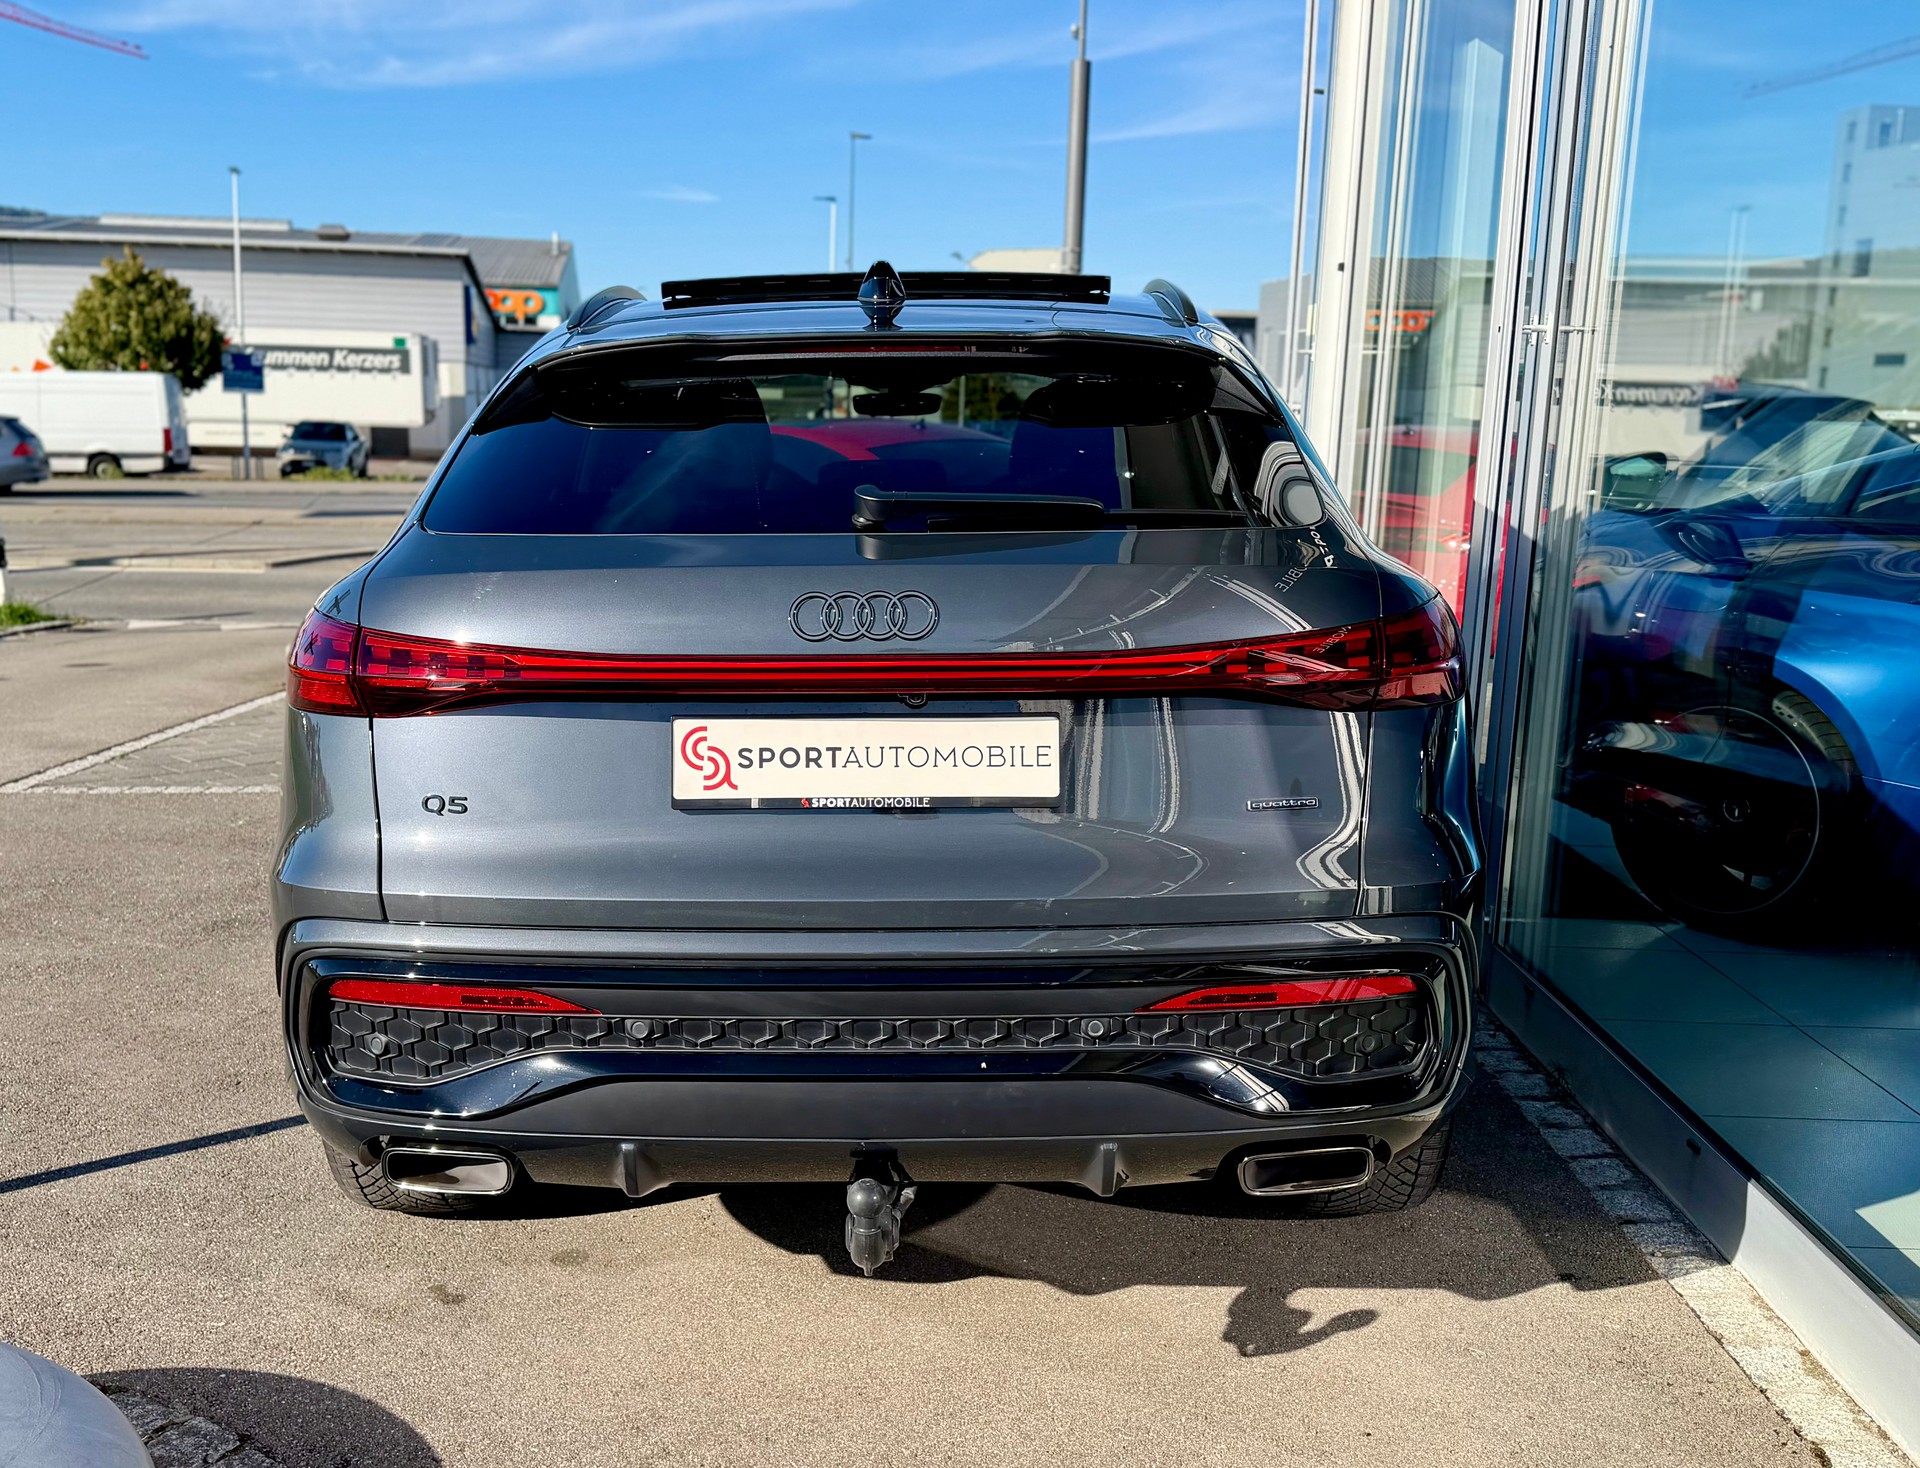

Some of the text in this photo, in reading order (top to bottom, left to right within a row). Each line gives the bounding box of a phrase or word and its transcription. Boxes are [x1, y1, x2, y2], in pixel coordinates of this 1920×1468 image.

[332, 350, 402, 369] Kerzers
[737, 745, 1052, 769] SPORTAUTOMOBILE
[421, 794, 468, 817] Q5
[811, 797, 931, 809] SPORTAUTOMOBILE
[1252, 798, 1317, 810] quattro
